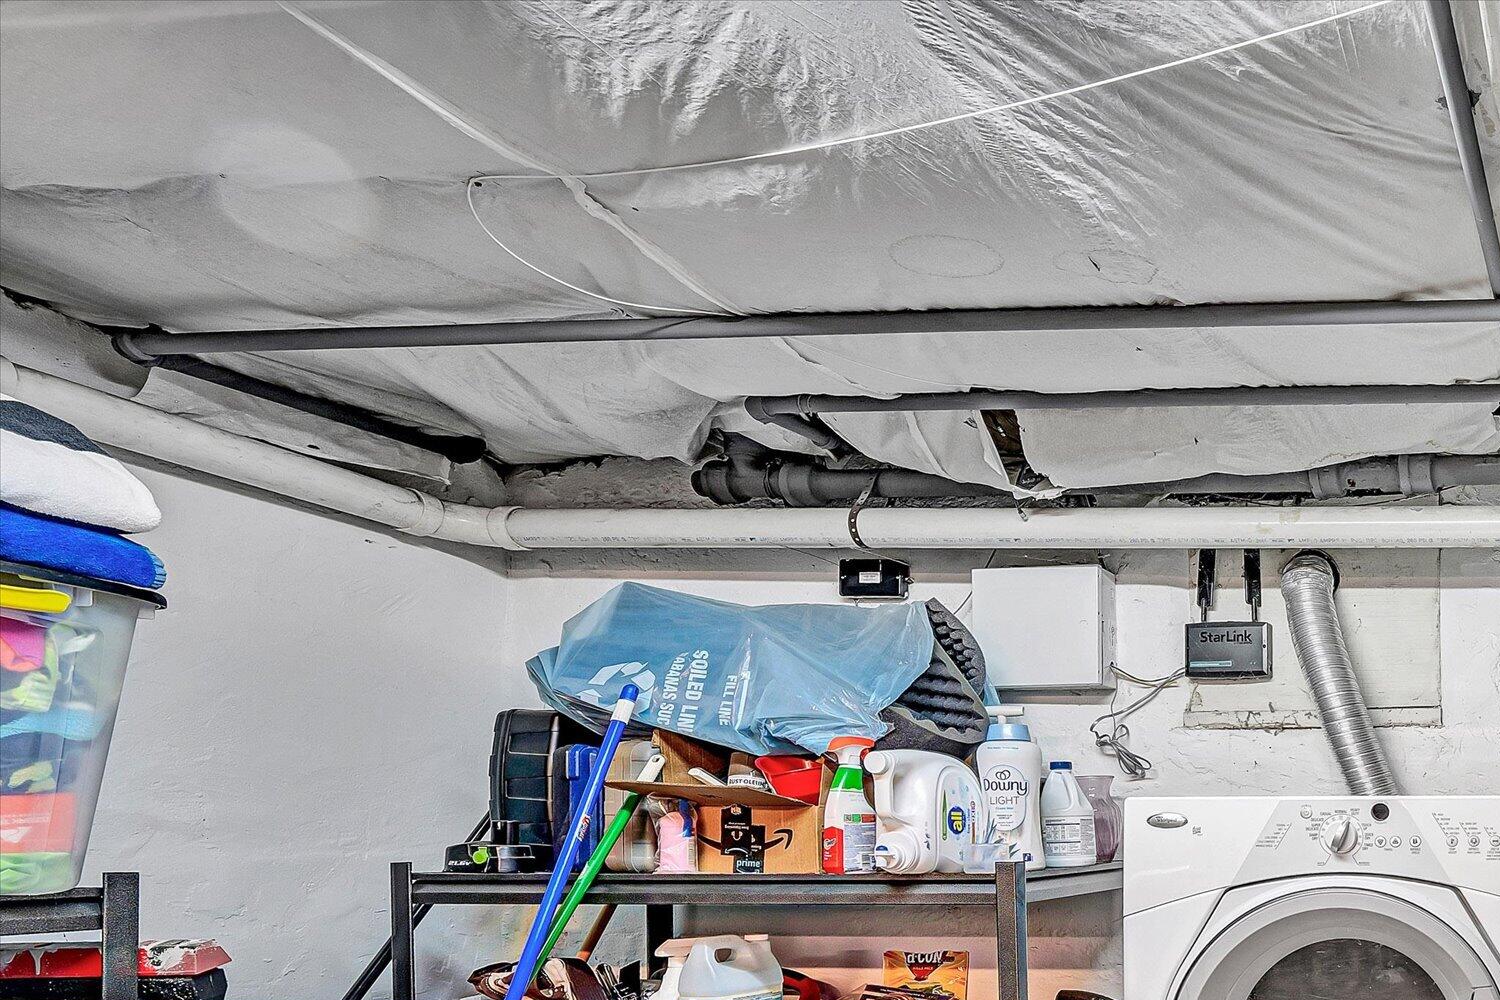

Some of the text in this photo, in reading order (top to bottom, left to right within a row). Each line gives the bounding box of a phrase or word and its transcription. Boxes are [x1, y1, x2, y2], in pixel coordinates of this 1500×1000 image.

[1200, 630, 1253, 643] StarLink
[685, 649, 709, 701] SOILED
[718, 674, 738, 726] FILL LINE
[983, 779, 1028, 796] Downy
[990, 796, 1020, 805] LIGHT
[951, 811, 962, 832] all
[736, 859, 760, 868] prime
